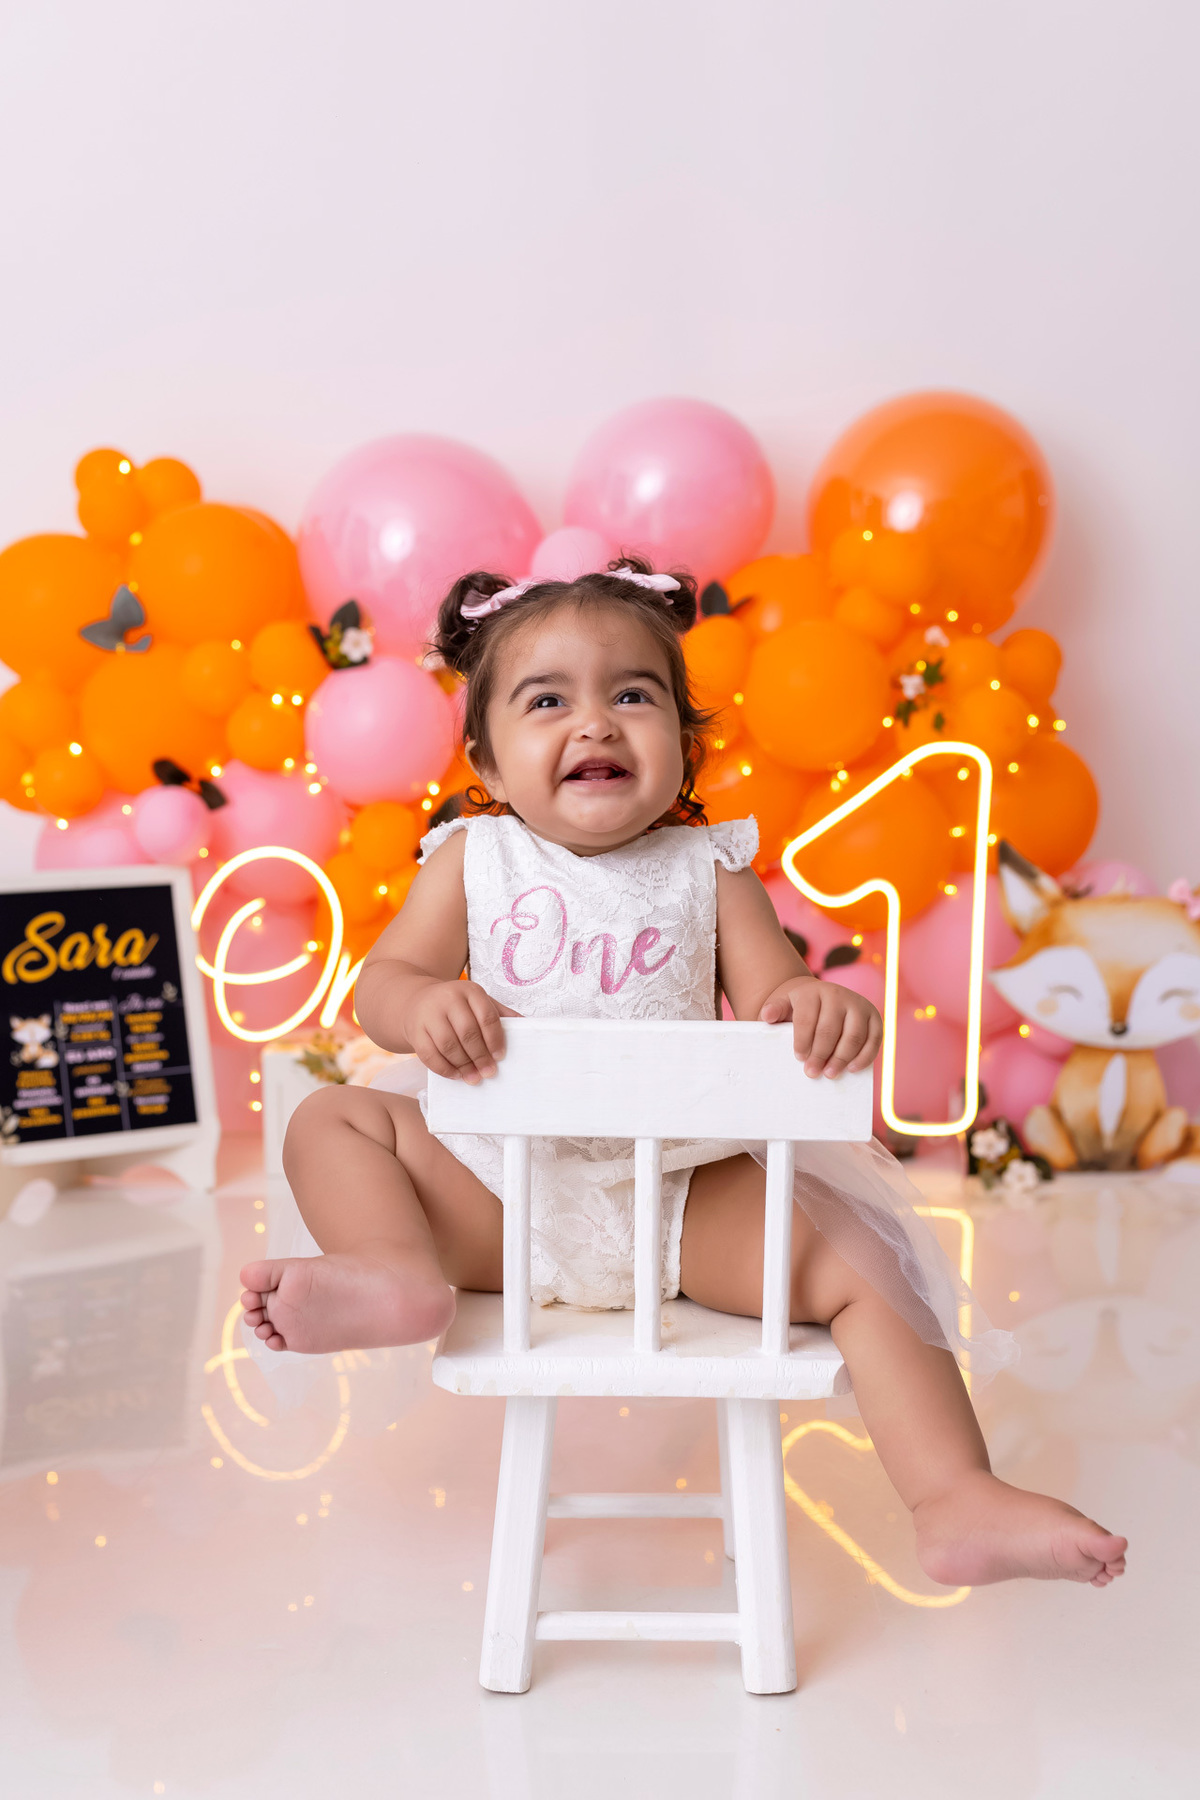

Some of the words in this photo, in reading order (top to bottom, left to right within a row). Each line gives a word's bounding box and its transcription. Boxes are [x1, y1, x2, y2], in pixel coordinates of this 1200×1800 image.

[2, 911, 159, 984] Sara
[490, 885, 677, 995] One
[781, 741, 993, 1137] 1
